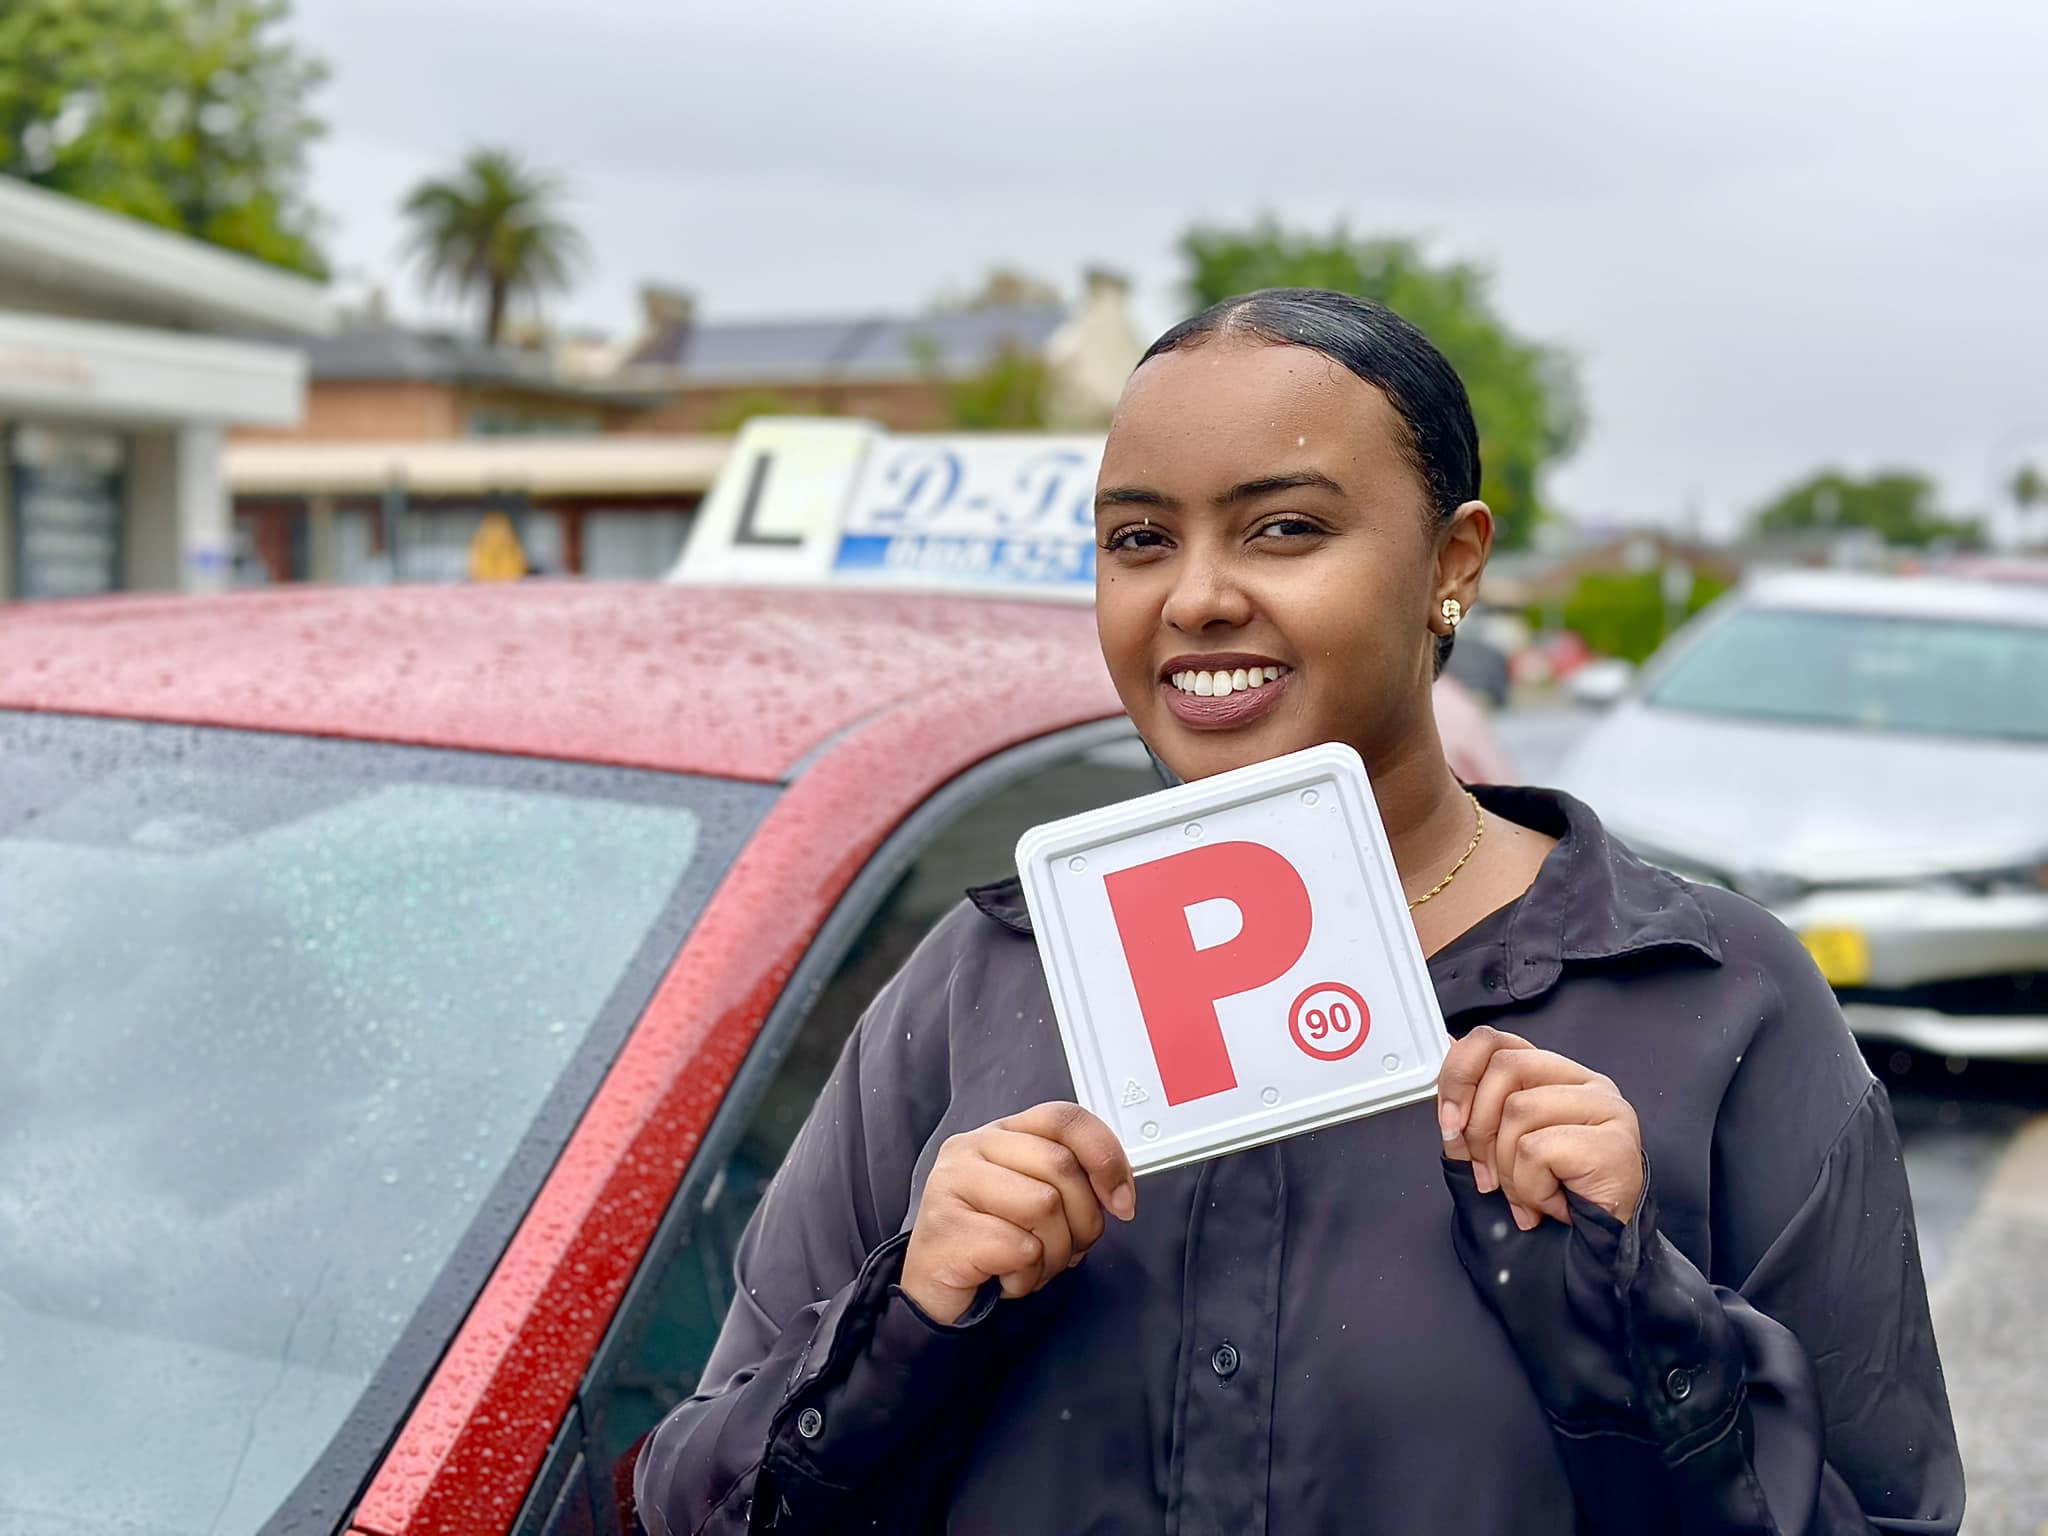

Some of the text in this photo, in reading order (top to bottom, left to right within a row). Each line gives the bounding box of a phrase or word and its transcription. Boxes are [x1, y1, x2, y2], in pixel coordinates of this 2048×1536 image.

[733, 452, 806, 546] L
[1103, 840, 1313, 1107] P
[1305, 1002, 1352, 1039] 90
